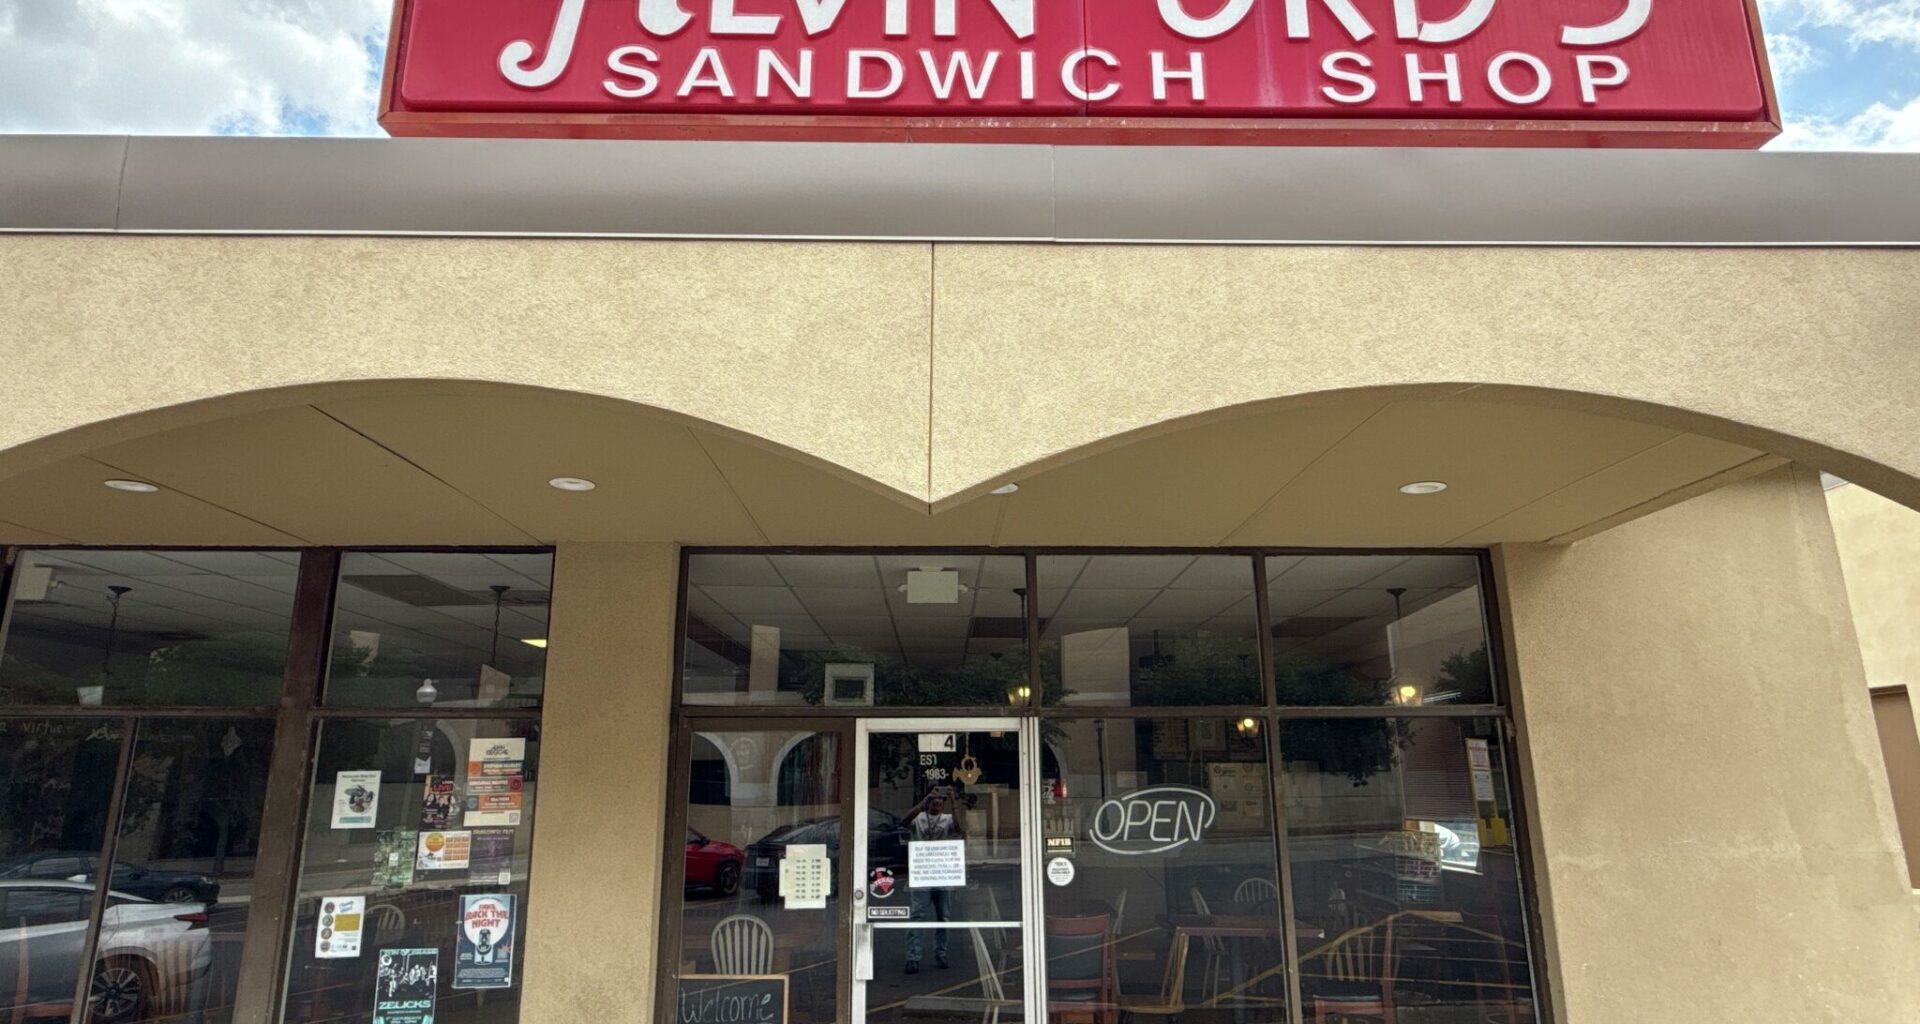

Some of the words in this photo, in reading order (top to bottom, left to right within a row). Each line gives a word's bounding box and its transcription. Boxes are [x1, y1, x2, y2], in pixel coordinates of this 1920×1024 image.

[602, 45, 1205, 101] SANDWICH
[1321, 50, 1630, 104] SHOP
[943, 734, 954, 750] 4
[1094, 799, 1205, 841] OPEN
[1047, 838, 1072, 847] NFIB
[465, 910, 489, 921] BACK
[471, 919, 501, 929] NIGHT
[378, 1000, 432, 1010] ZELICKS
[680, 987, 775, 1023] Welcome
